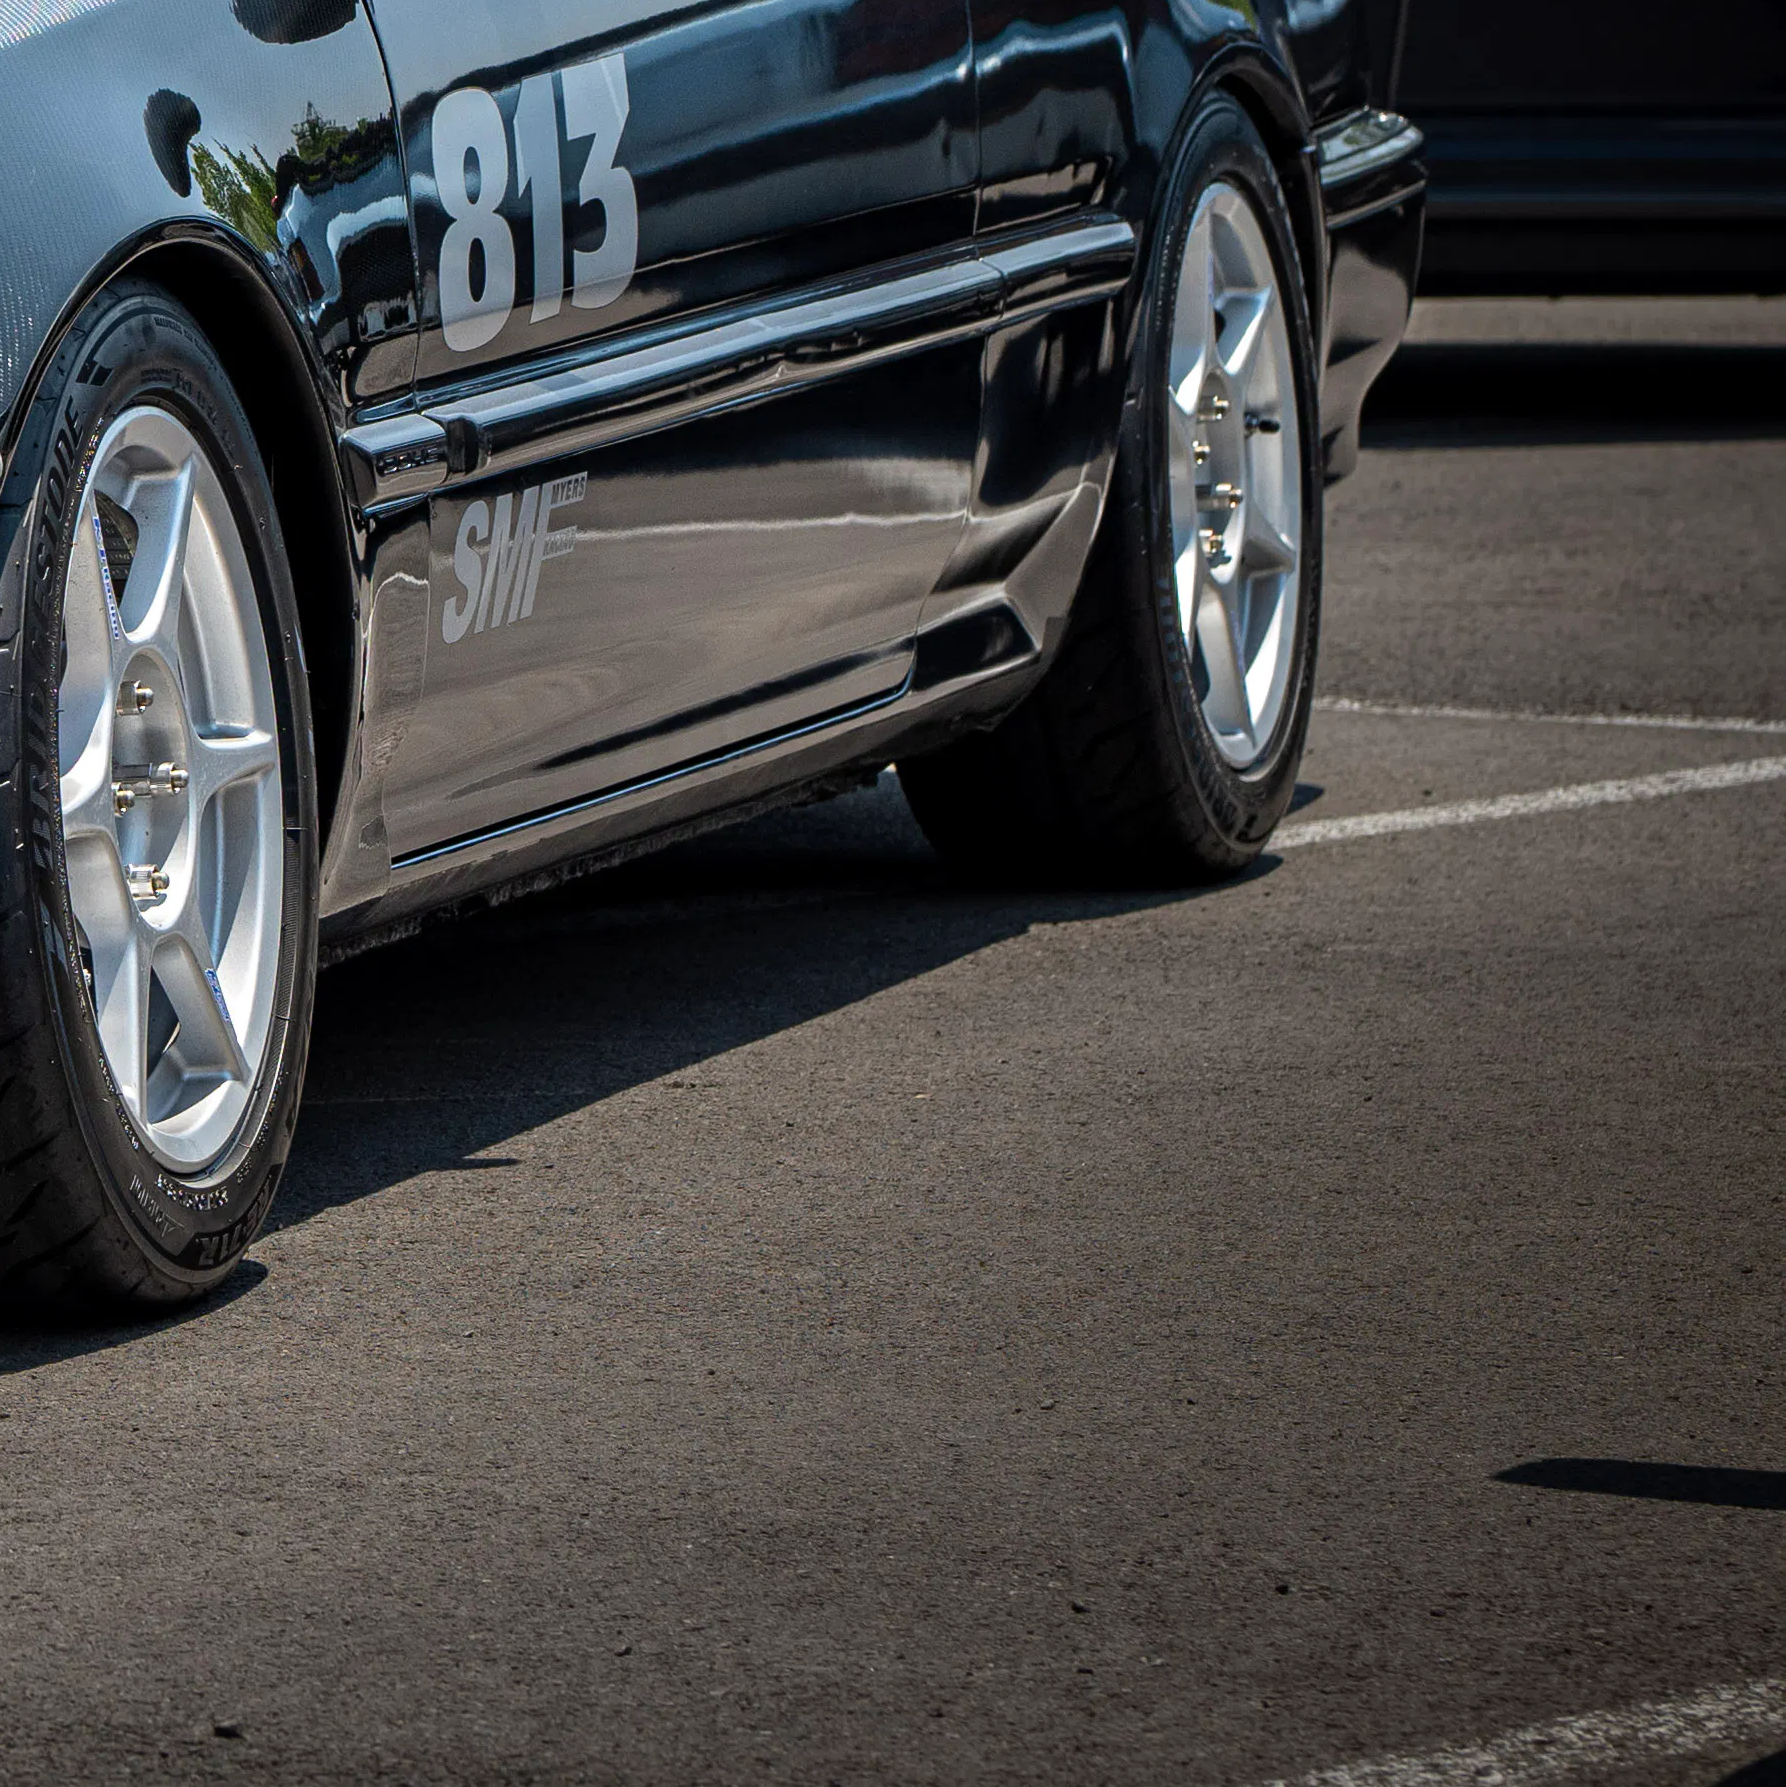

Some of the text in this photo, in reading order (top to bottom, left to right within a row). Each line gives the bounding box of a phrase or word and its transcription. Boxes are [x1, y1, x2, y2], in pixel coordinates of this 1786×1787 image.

[431, 52, 639, 353] 813
[30, 395, 85, 872] BRIDGESTONE
[551, 476, 586, 504] MYERS
